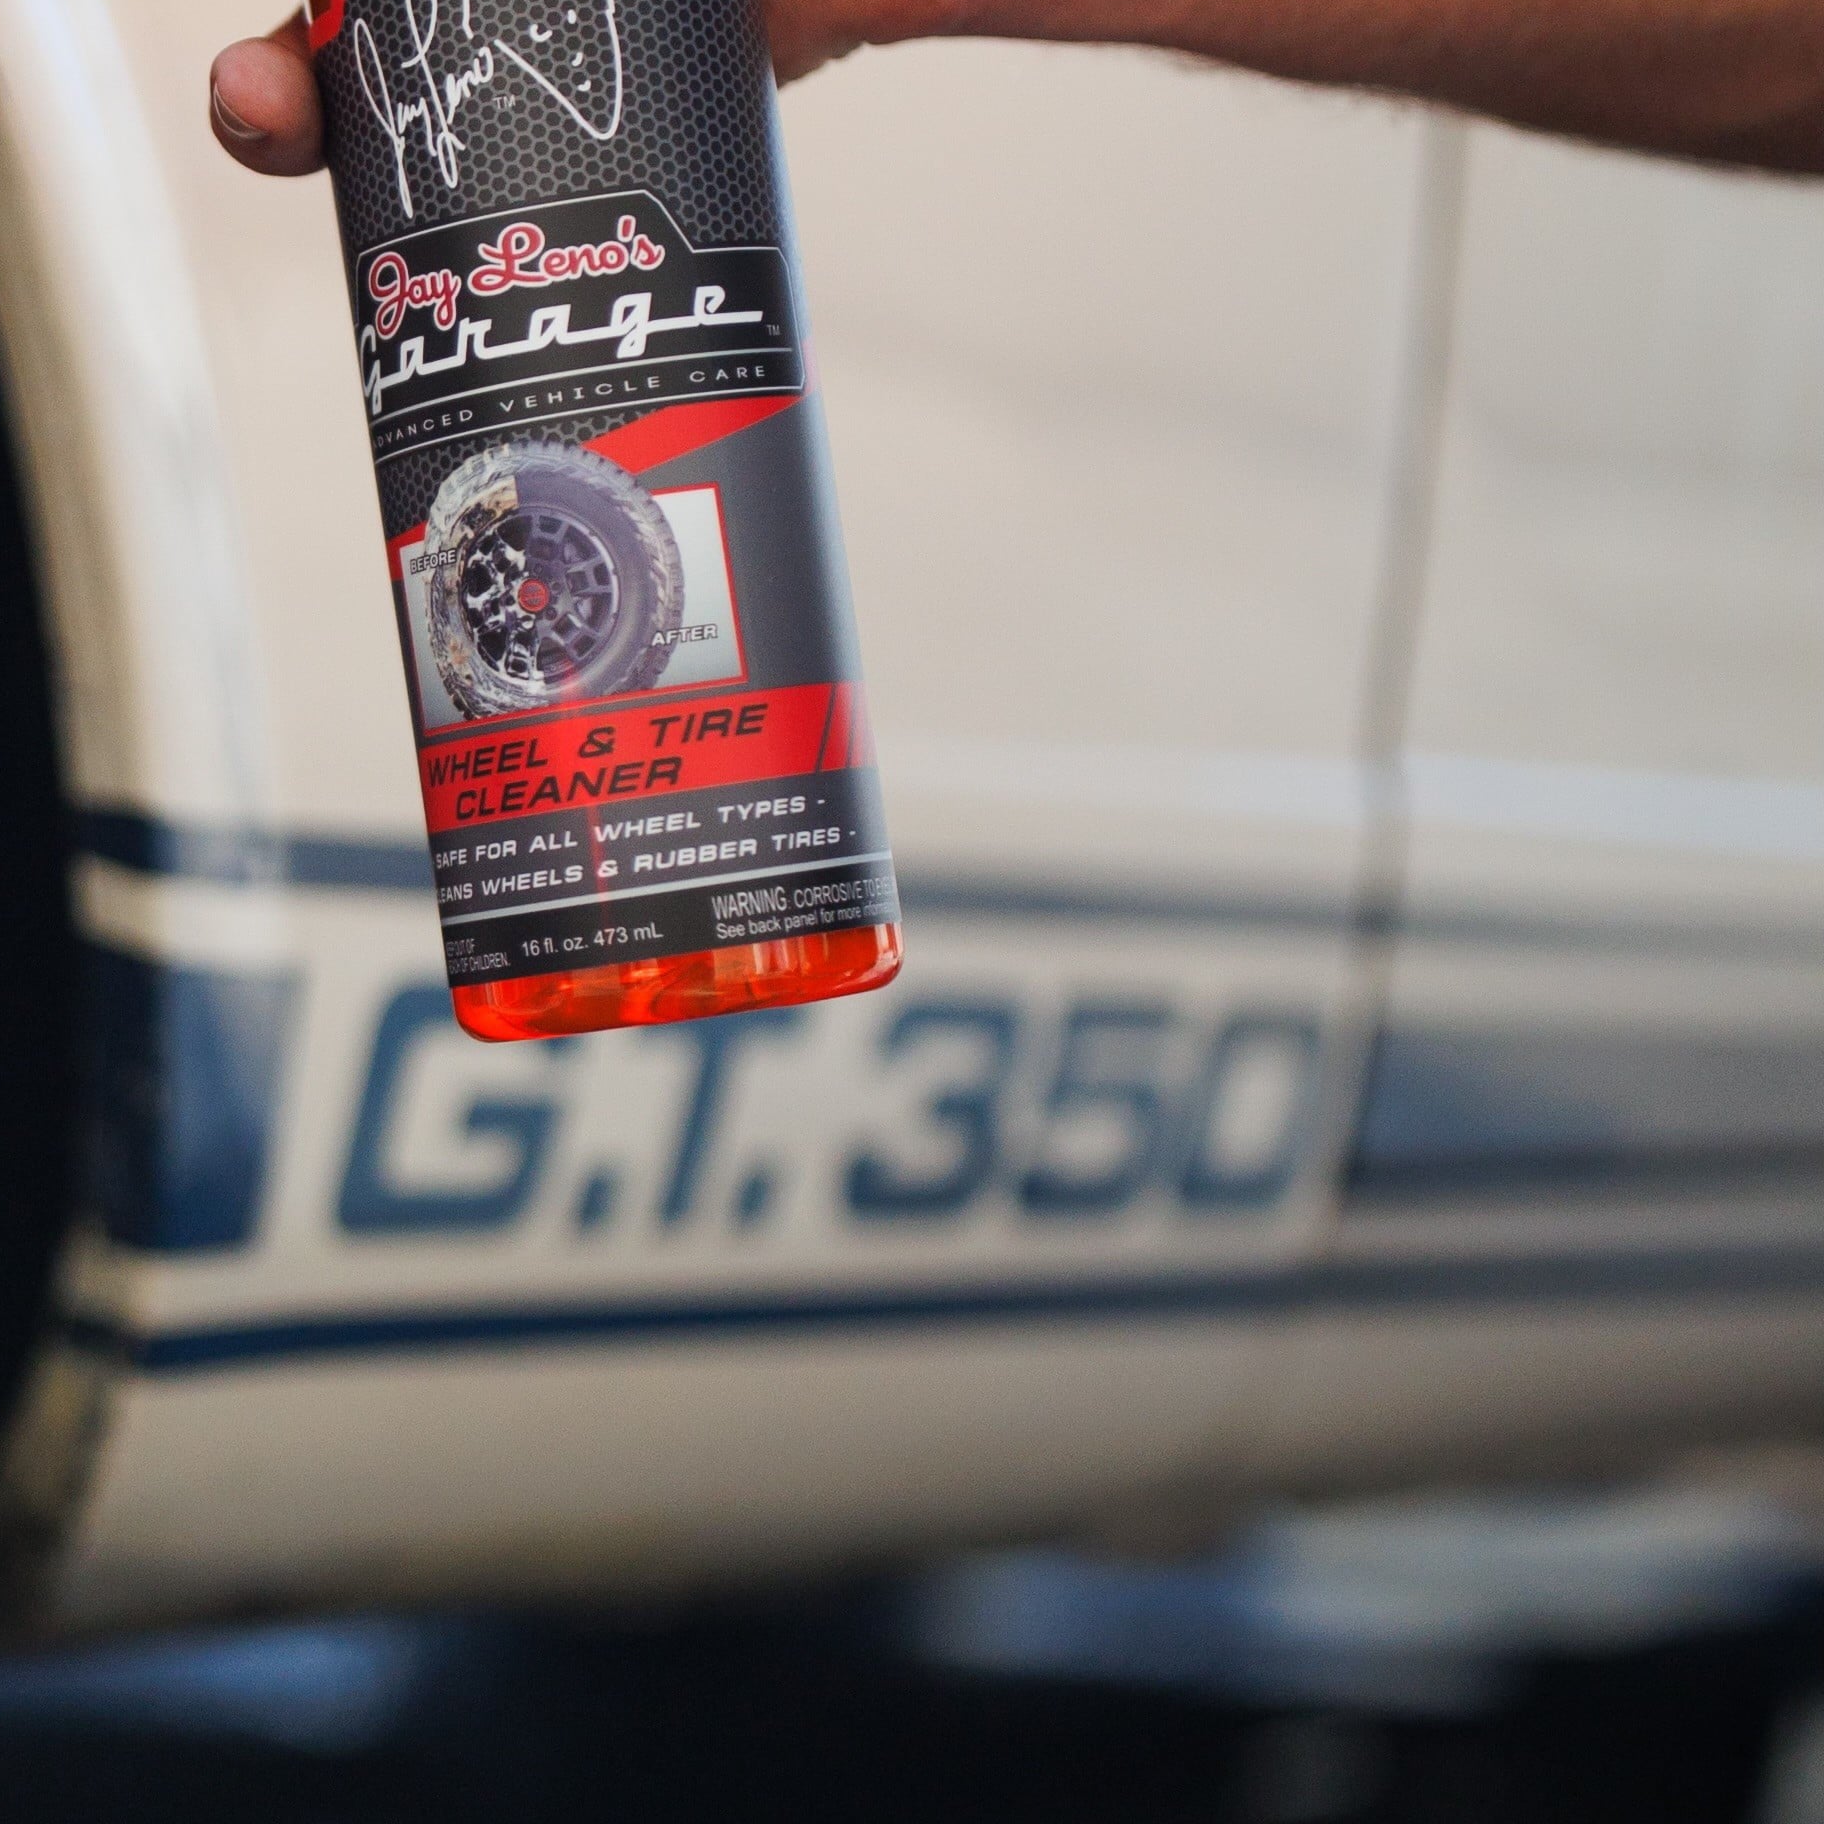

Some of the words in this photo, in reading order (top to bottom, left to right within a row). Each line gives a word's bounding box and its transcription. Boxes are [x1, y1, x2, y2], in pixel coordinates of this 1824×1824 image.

[368, 251, 462, 340] Jay
[468, 215, 665, 296] Leno's
[359, 285, 763, 415] Garage
[372, 409, 474, 449] DVANCED
[500, 376, 661, 412] VEHICLE
[689, 365, 766, 383] CARE
[409, 548, 457, 575] BEFORE
[651, 624, 718, 647] AFTER
[428, 737, 548, 787] WHEEL
[578, 725, 616, 758] &
[649, 703, 769, 748] TIRE
[456, 756, 683, 821] CLEANER
[436, 848, 467, 869] SAFE
[475, 839, 517, 863] FOR
[529, 830, 578, 854] ALL
[594, 811, 701, 843] WHEEL
[717, 796, 806, 824] TYPES
[481, 865, 584, 896] WHEELS
[597, 859, 620, 878] &
[633, 838, 757, 874] RUBBER
[771, 827, 841, 852] TIRES
[716, 922, 746, 941] See
[749, 916, 781, 935] back
[784, 911, 818, 932] panel
[820, 908, 835, 924] for
[837, 905, 861, 921] more
[793, 881, 863, 909] CORROSIVE
[522, 939, 540, 957] 16
[544, 937, 559, 954] fl.
[563, 936, 589, 952] oz.
[594, 927, 628, 947] 473
[633, 922, 664, 941] mL
